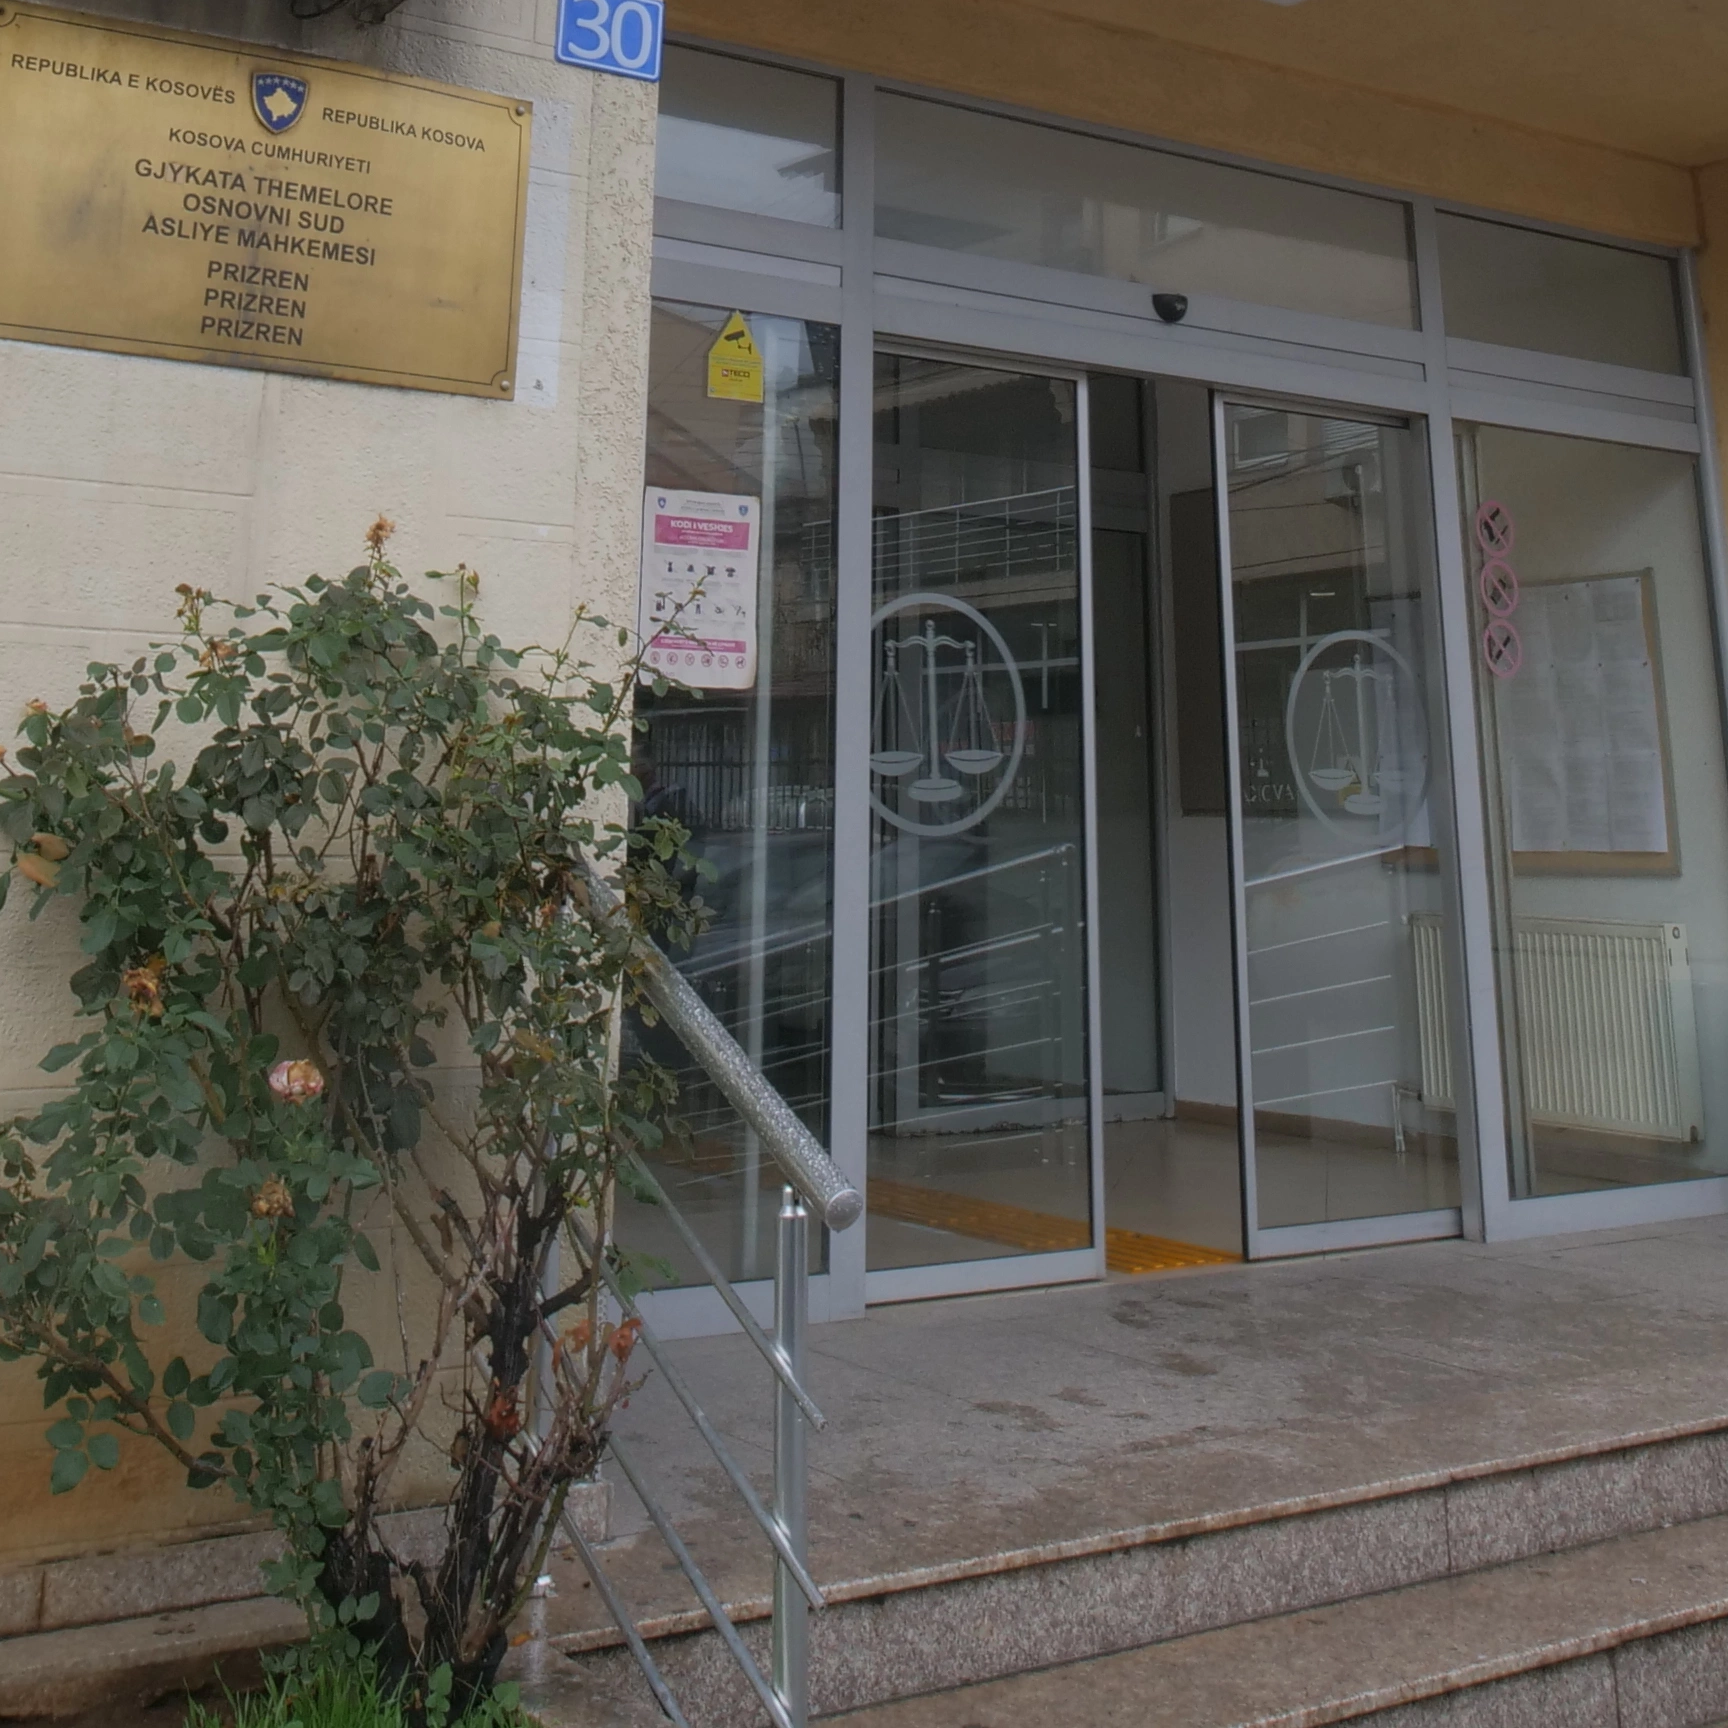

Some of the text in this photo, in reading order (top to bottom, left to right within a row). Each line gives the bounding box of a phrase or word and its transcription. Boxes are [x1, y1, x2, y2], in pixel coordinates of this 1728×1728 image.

[10, 54, 236, 104] REPUBLIKA E KOSOVËS
[168, 128, 371, 174] KOSOVA CUMHURIYETI
[321, 107, 486, 153] REPUBLIKA KOSOVA
[134, 159, 393, 216] GJYKATA THEMELORE
[183, 193, 345, 234] OSNOVNI SUD
[142, 215, 376, 266] ASLIYE MAHKEMESI
[207, 260, 309, 292] PRIZREN
[203, 288, 306, 318] PRIZREN
[200, 315, 303, 346] PRIZREN
